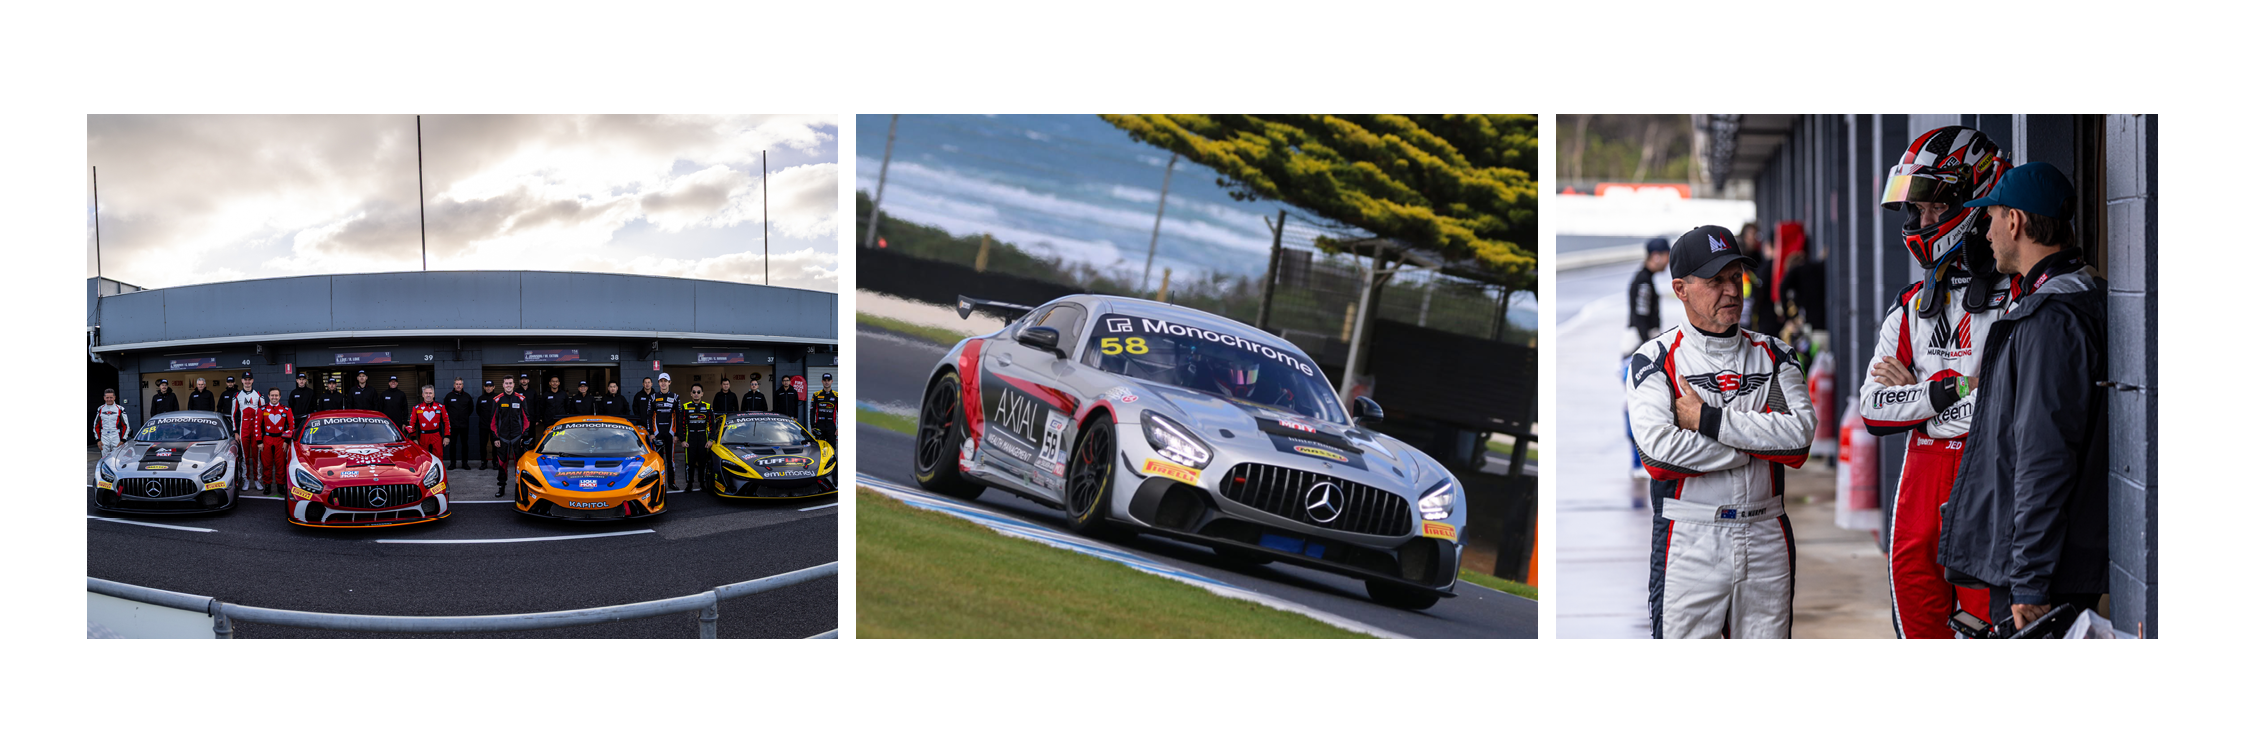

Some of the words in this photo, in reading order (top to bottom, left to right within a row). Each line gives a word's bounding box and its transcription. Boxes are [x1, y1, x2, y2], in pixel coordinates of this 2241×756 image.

[1952, 230, 1962, 240] Jed
[1100, 337, 1149, 355] 58
[1142, 319, 1314, 376] Monochrome
[1635, 362, 1654, 380] freem
[1874, 389, 1923, 407] freem
[158, 417, 218, 426] Monochrome
[324, 417, 390, 425] Monochrome
[994, 388, 1038, 443] AXIAL
[141, 426, 156, 435] 58
[566, 423, 634, 431] Monochrome
[1280, 420, 1315, 433] MOLY
[987, 433, 1004, 447] WEALTH
[1003, 440, 1032, 462] MANAGEMENT
[1042, 431, 1057, 460] 58
[1946, 441, 1962, 449] JED
[1146, 461, 1197, 482] PIRELLI
[292, 487, 312, 499] PIRELLI
[1424, 523, 1456, 538] PIRELLI
